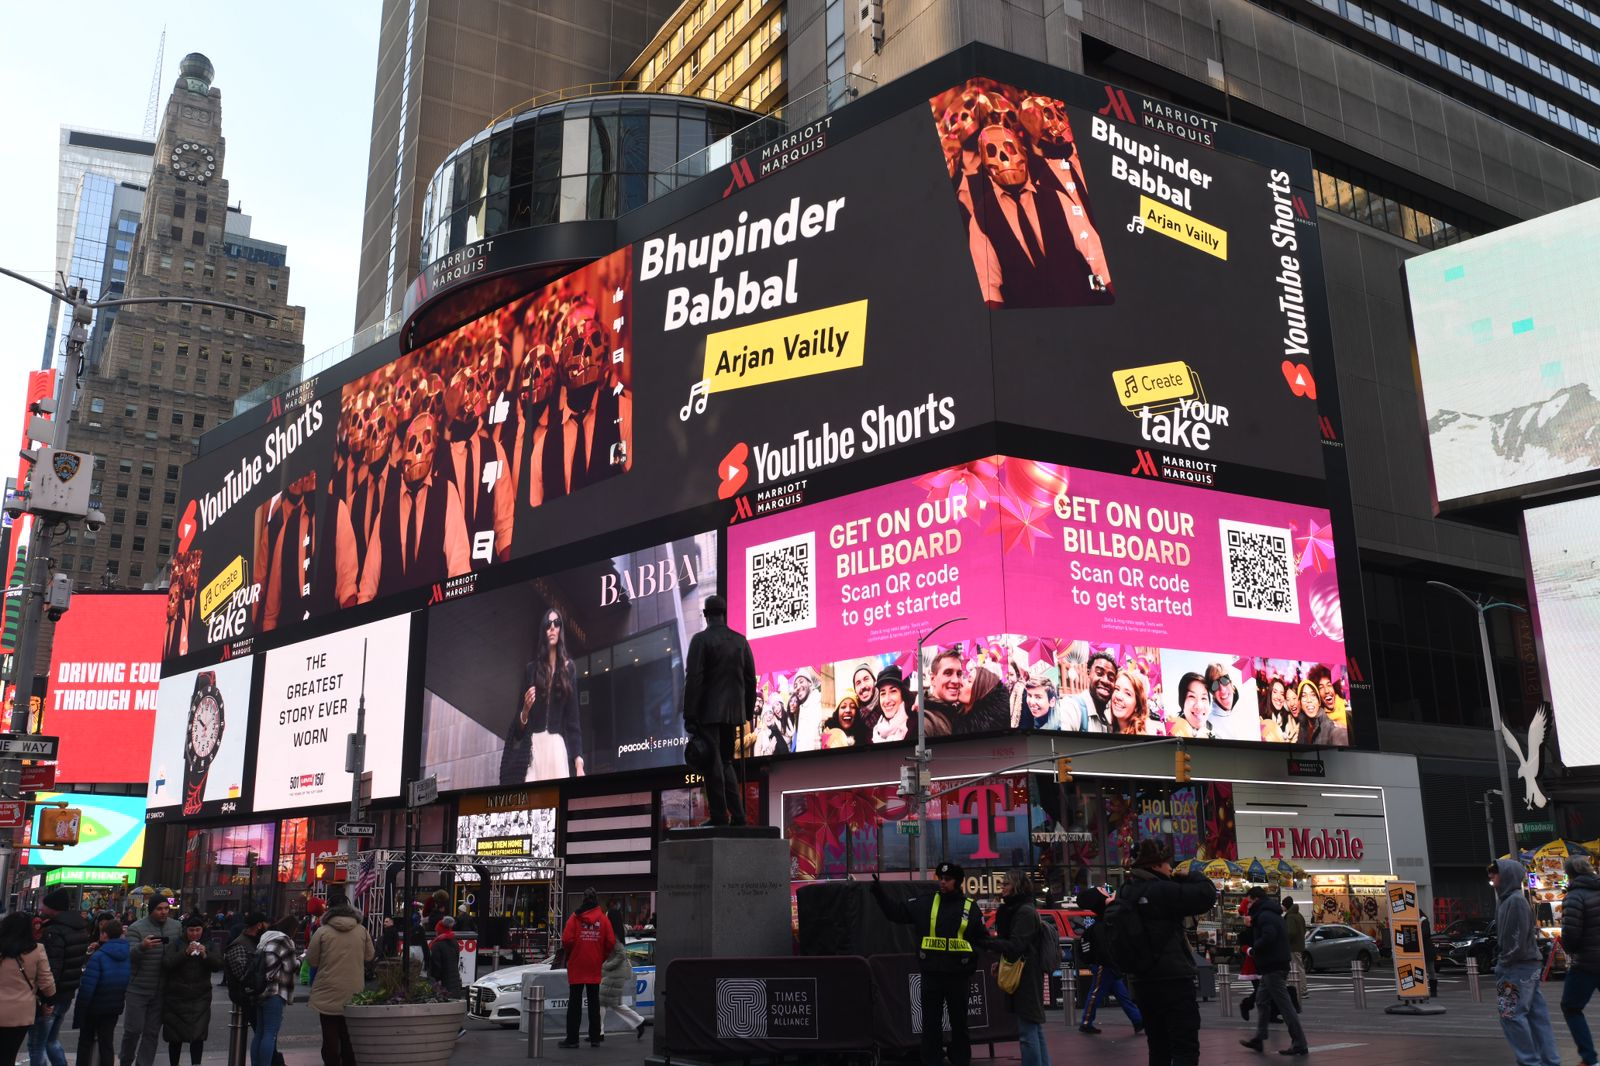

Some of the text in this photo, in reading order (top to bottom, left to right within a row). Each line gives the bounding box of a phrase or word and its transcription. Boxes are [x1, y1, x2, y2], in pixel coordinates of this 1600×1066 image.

[1143, 100, 1218, 133] MARRIOTT
[1145, 116, 1212, 145] MARQUIS
[760, 116, 833, 160] MARRIOTT
[761, 136, 825, 177] MARQUIS
[1091, 116, 1213, 190] Bhupinder
[1111, 154, 1192, 210] Babbal
[640, 196, 846, 282] Bhupinder
[1147, 209, 1219, 250] Arjan Vailly
[432, 240, 494, 275] MARRIOTT
[1267, 169, 1309, 355] YouTube Shorts
[432, 258, 485, 290] MARQUIS
[663, 259, 799, 332] Babbal
[715, 326, 849, 378] Arjan Vailly
[286, 377, 319, 400] MARRIOTT
[1142, 372, 1183, 392] Create
[285, 390, 314, 410] MARQUIS
[1178, 398, 1229, 427] YOUR
[753, 393, 955, 484] YouTube Shorts
[1139, 405, 1211, 451] take
[200, 400, 323, 532] YouTube Shorts
[1163, 455, 1217, 473] MARRIOTT
[1164, 468, 1213, 484] MARQUIS
[757, 480, 807, 501] MARRIOTT
[757, 494, 802, 513] MARQUIS
[830, 495, 968, 549] GET ON OUR
[1054, 492, 1195, 537] GET ON OUR
[836, 529, 962, 578] BILLBOARD
[1063, 526, 1191, 567] BILLBOARD
[214, 570, 238, 597] Create
[445, 584, 474, 597] MARQUIS
[446, 574, 478, 588] MARRIOTT
[600, 554, 697, 607] BABBA
[841, 564, 959, 603] Scan QR code
[1070, 561, 1190, 593] Scan QR code
[232, 583, 261, 610] YOUR
[842, 585, 961, 626] to get started
[1071, 587, 1192, 617] to get started
[208, 602, 247, 644] take
[232, 638, 254, 649] MARRIOTT
[232, 646, 251, 656] MARQUIS
[58, 662, 126, 683] DRIVING
[306, 653, 327, 671] THE
[54, 689, 131, 710] THROUGH
[286, 674, 344, 700] GREATEST
[280, 699, 348, 726] STORY EVER
[22, 742, 48, 752] WAY
[293, 727, 328, 748] WORN
[618, 736, 689, 757] peacock SEPHORA
[685, 774, 704, 784] SEP
[1141, 799, 1199, 817] HOLIDAY
[1524, 823, 1554, 832] Broadway
[1292, 829, 1364, 860] Mobile
[924, 938, 946, 949] TIMES
[771, 1004, 812, 1016] SQUARE
[774, 991, 808, 1002] TIMES
[774, 1017, 810, 1026] ALLIANCE
